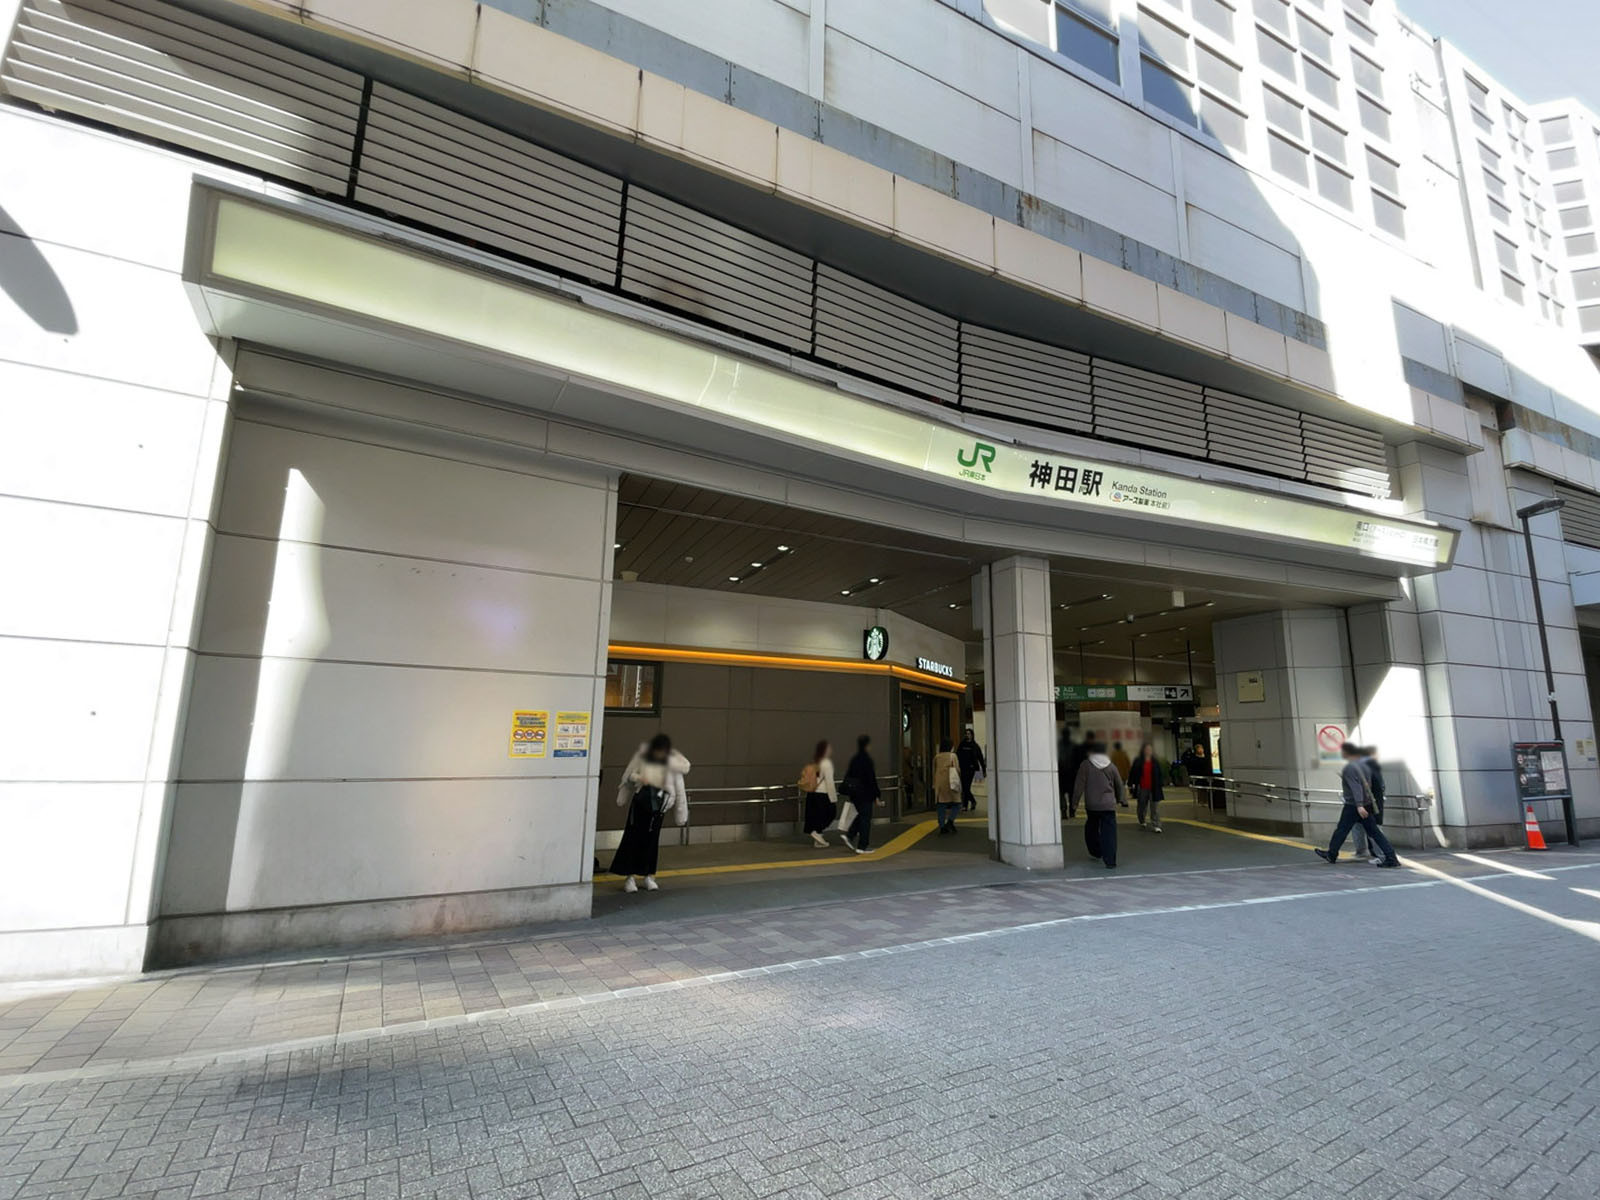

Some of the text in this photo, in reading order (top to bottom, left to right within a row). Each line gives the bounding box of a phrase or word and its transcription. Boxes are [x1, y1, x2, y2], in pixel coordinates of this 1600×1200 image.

[957, 442, 996, 473] JR
[1029, 460, 1104, 497] 神田駅
[1112, 481, 1167, 499] Kanda Station
[918, 657, 953, 677] STARBUCKS
